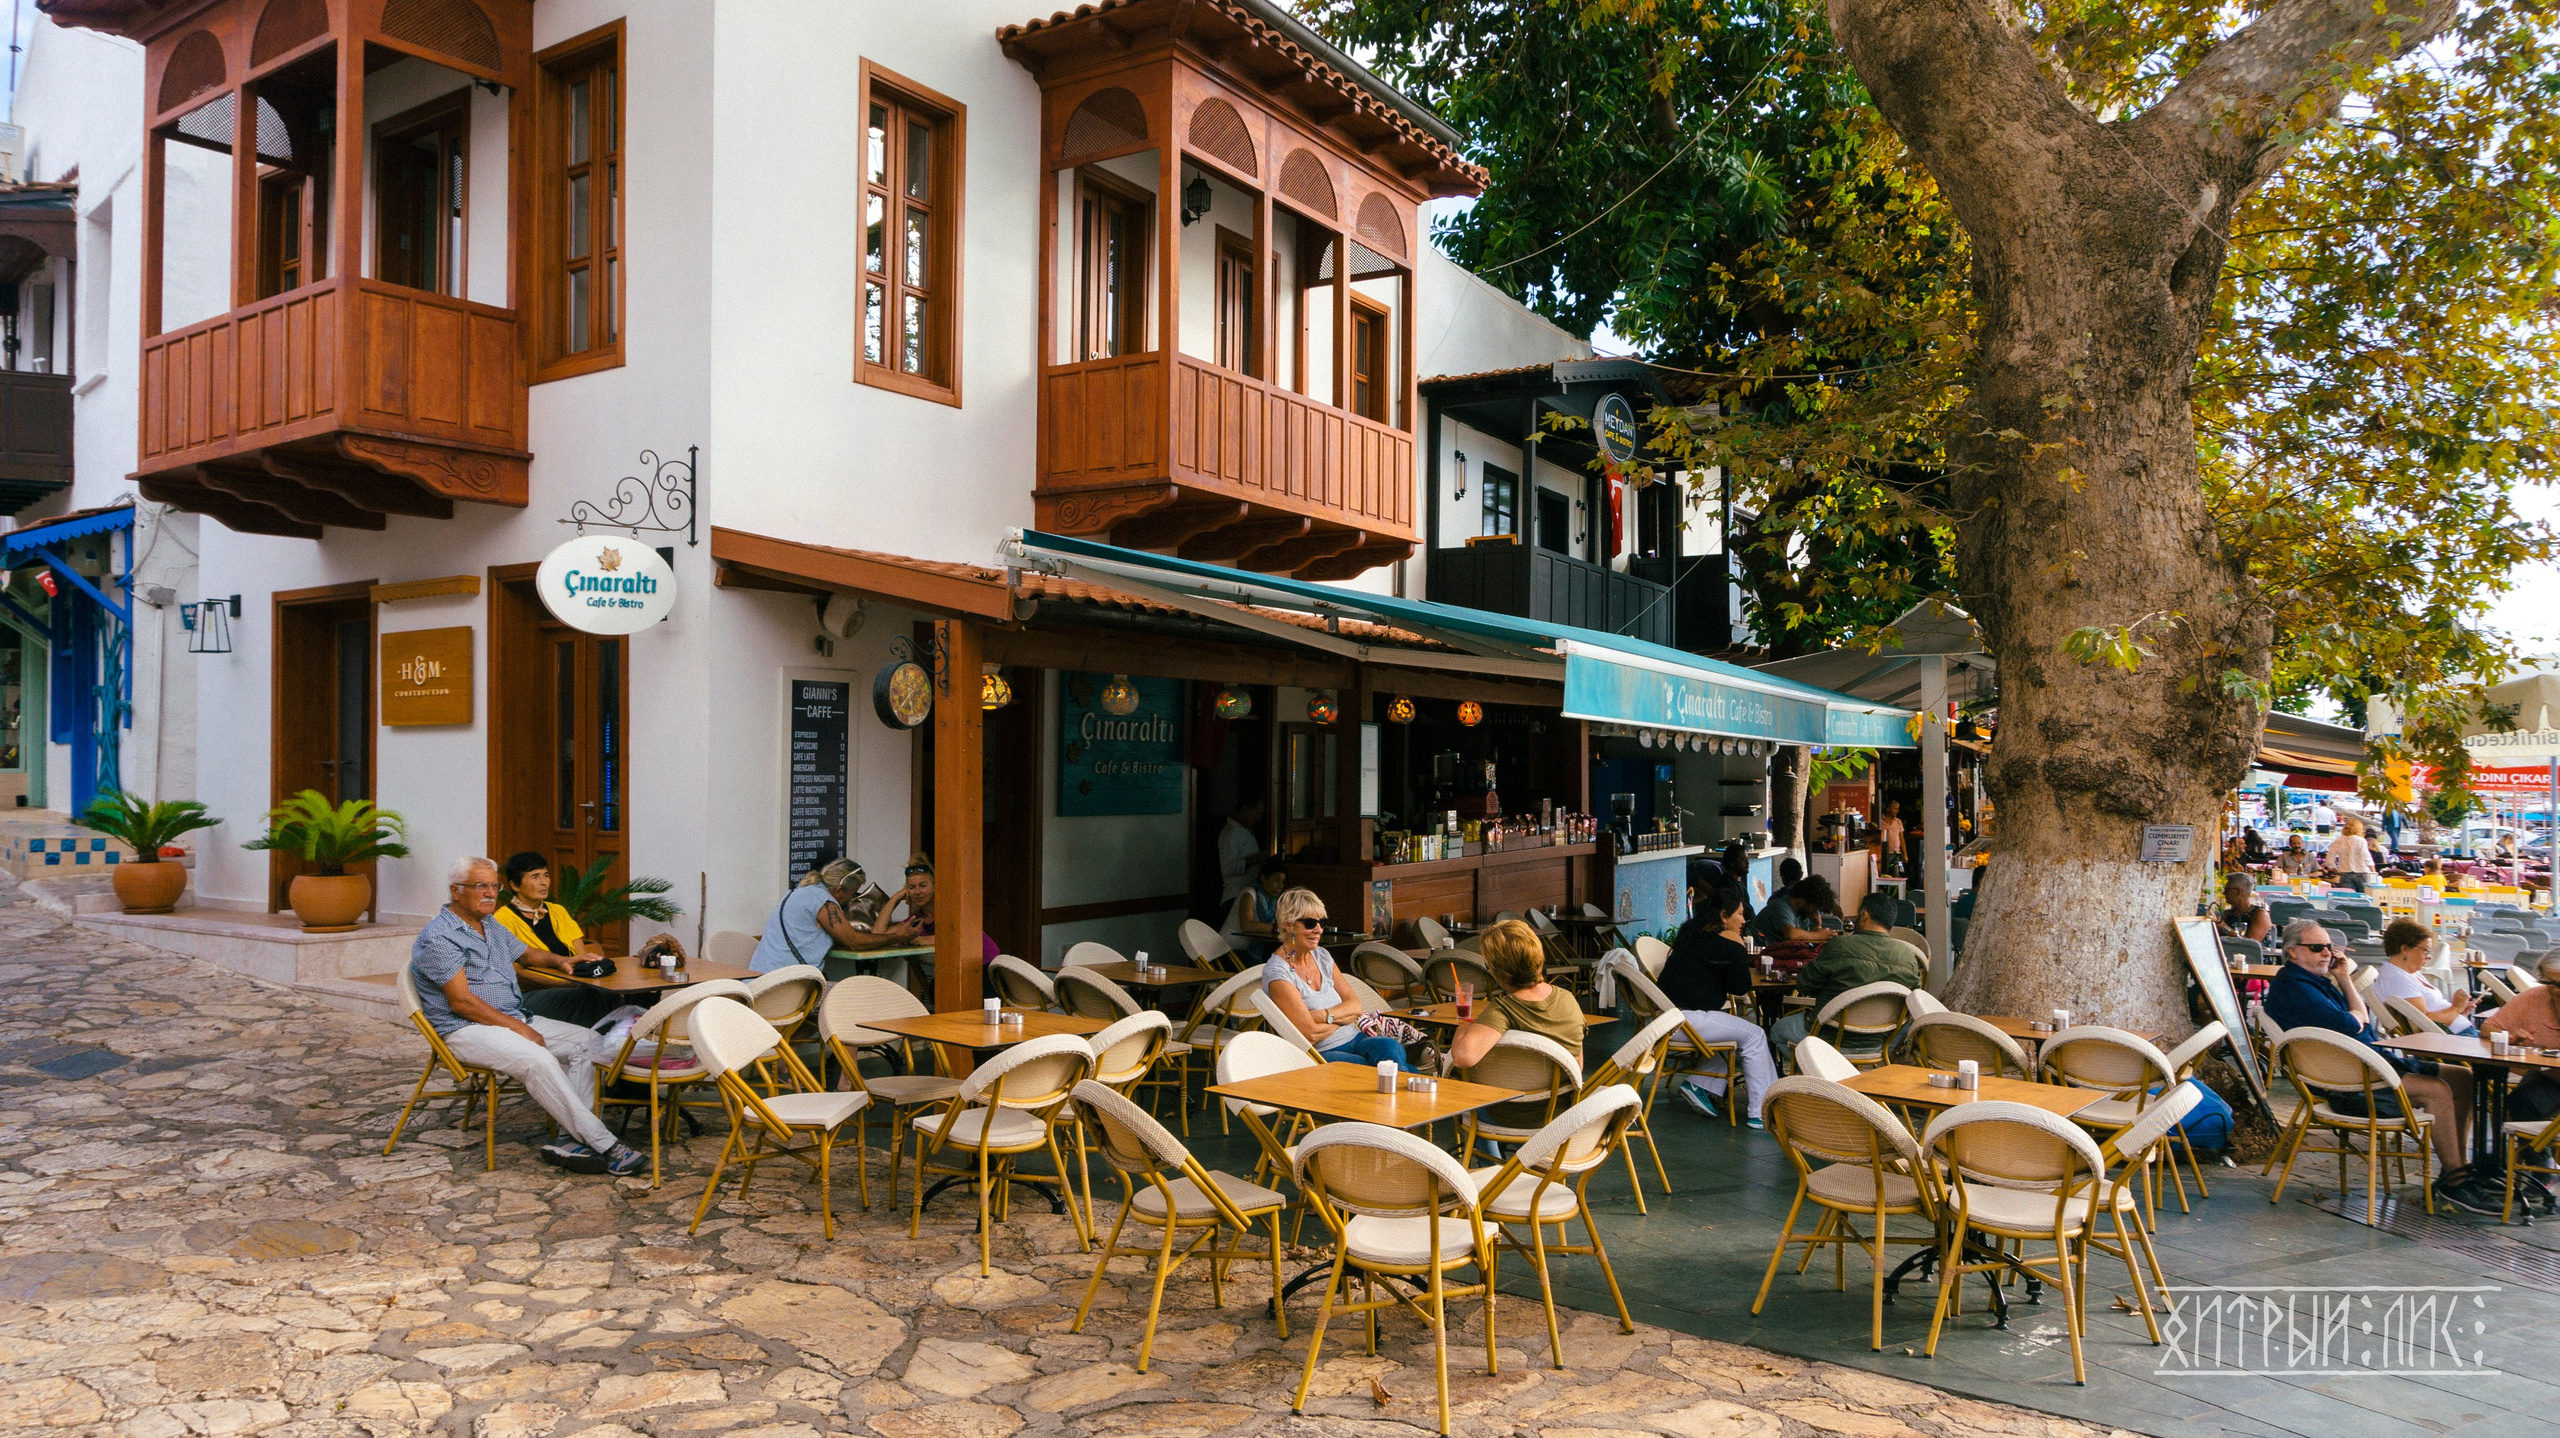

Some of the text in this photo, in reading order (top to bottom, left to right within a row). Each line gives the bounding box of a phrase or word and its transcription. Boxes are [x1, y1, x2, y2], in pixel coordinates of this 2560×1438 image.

[1605, 412, 1633, 437] MEYDAN
[565, 570, 657, 598] Çınaraltı
[586, 597, 644, 611] Cafe & Bistro
[394, 688, 449, 698] CONSTRUCTION
[802, 686, 838, 701] GIANNI'S
[807, 705, 832, 718] CAFFE
[1677, 684, 1773, 726] Çınaraltı Cafe & Bistro
[794, 731, 818, 739] ESPRESSO
[1082, 712, 1174, 749] Çınaraltı
[1095, 761, 1163, 775] Cafe & Bistro
